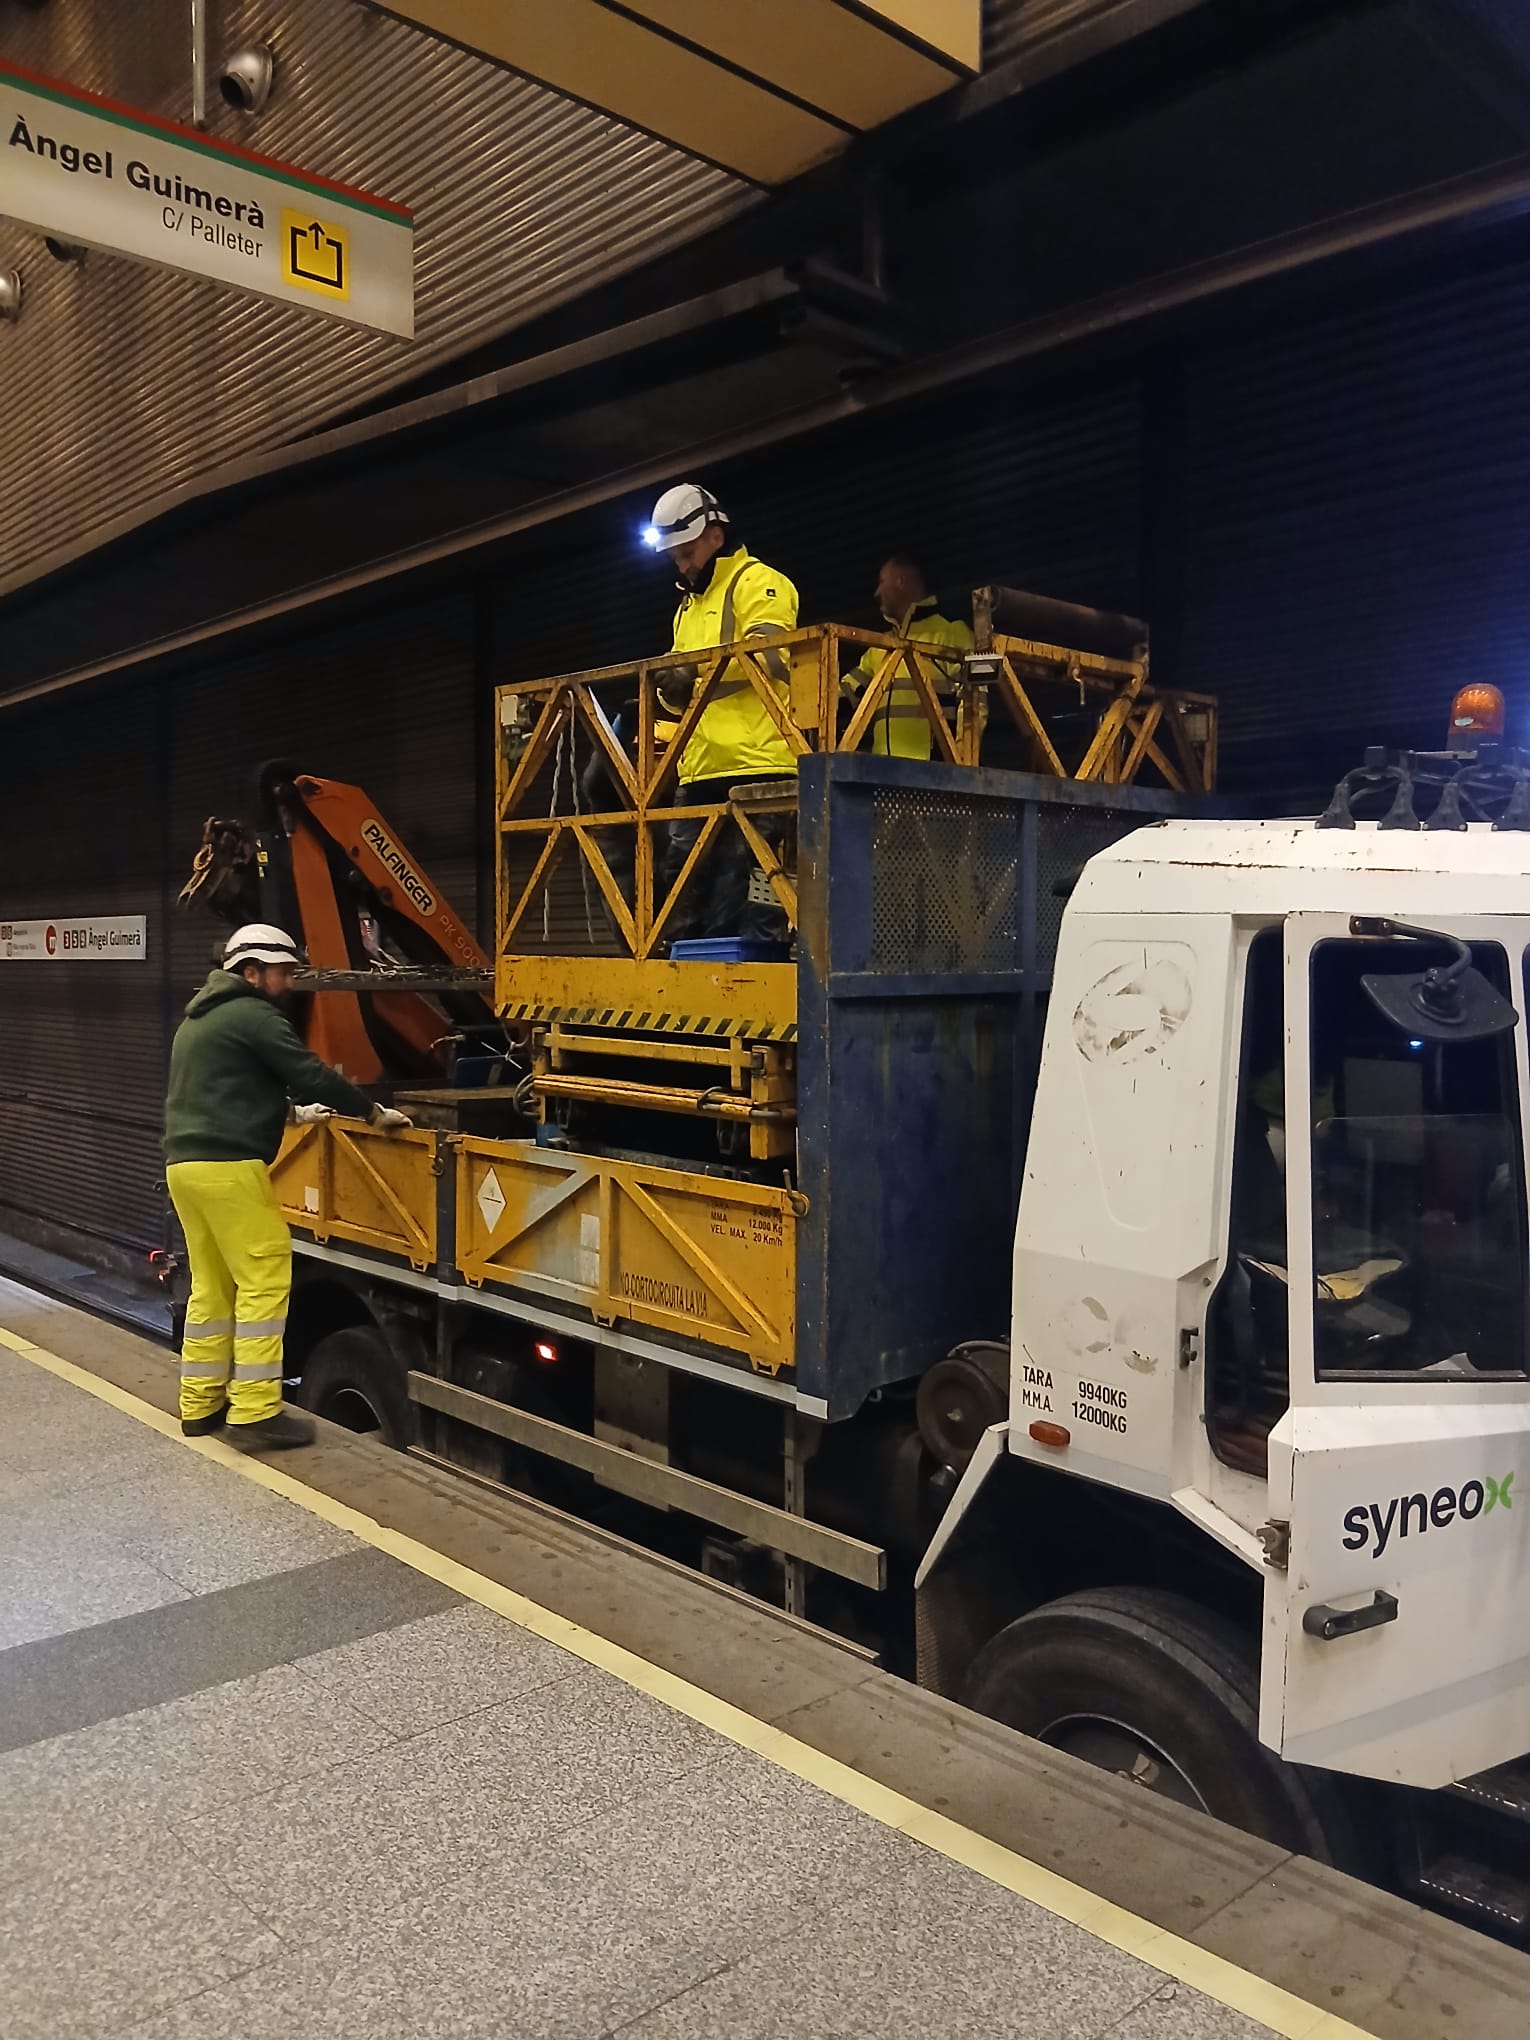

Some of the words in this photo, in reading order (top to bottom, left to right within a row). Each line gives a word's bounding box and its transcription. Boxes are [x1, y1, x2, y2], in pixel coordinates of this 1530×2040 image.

[9, 114, 113, 178] Àngel
[127, 161, 265, 229] Guimerà
[162, 207, 184, 232] C/
[192, 216, 263, 258] Palleter
[365, 824, 433, 912] PALFINGER
[110, 929, 141, 946] Guimerà
[440, 915, 457, 936] PK
[749, 1219, 771, 1232] 12.000
[772, 1223, 783, 1236] Kg
[753, 1232, 762, 1243] 20
[763, 1234, 783, 1247] Km/h
[1022, 1365, 1053, 1389] TARA
[1078, 1380, 1127, 1409] 9940KG
[1071, 1400, 1127, 1434] 12000KG
[1342, 1471, 1514, 1560] syneox
